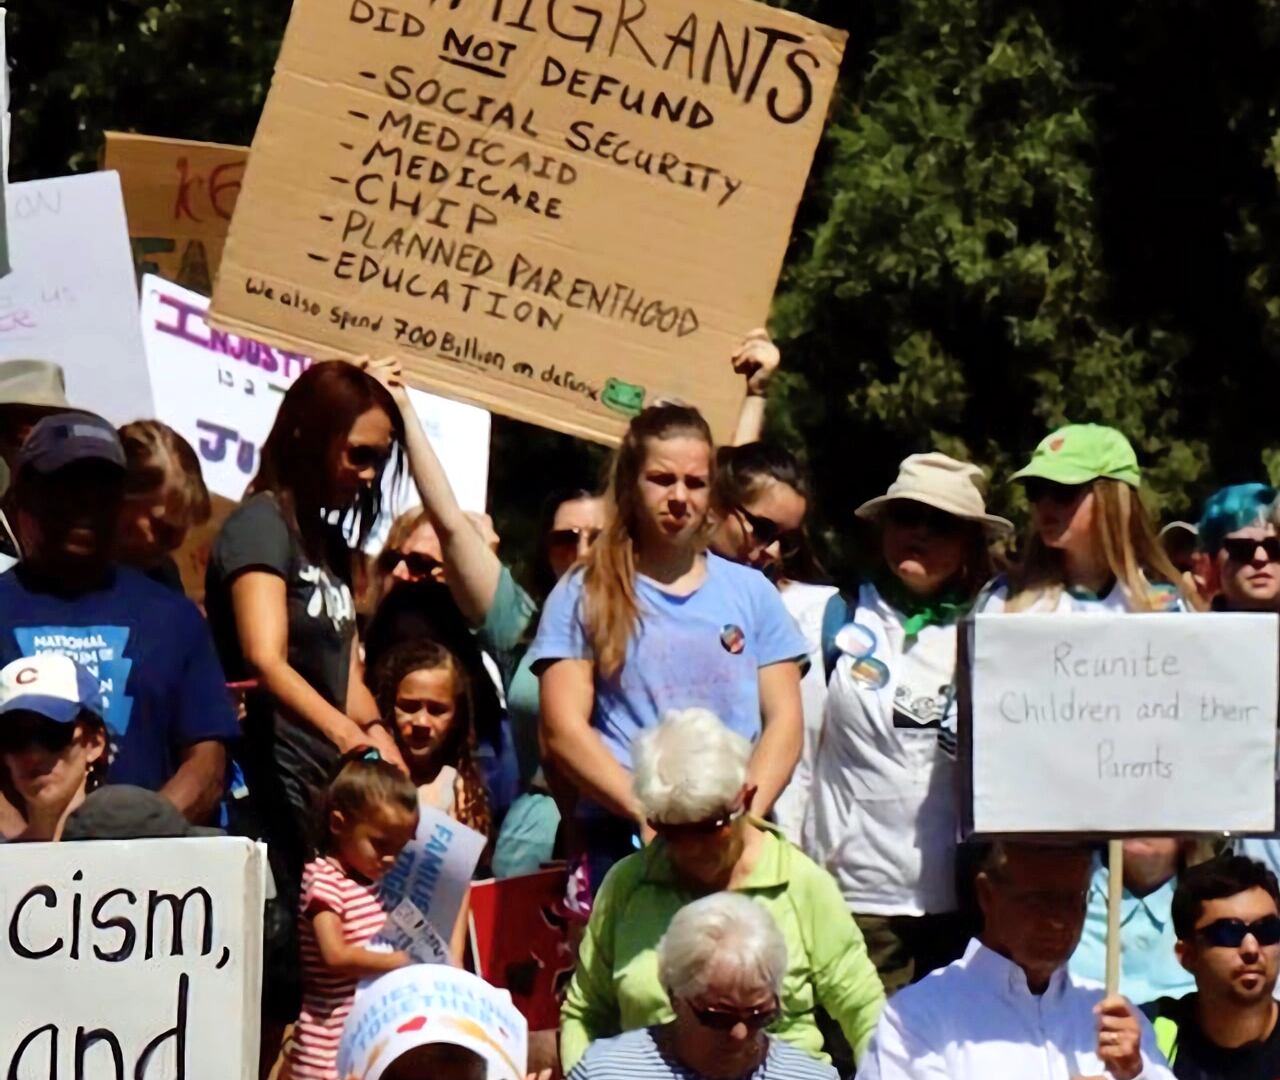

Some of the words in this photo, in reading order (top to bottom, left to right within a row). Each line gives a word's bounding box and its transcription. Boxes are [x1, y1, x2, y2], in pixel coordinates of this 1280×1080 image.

[350, 0, 425, 38] DID
[441, 28, 517, 70] NOT
[540, 56, 715, 129] DEFUND
[431, 0, 821, 124] IGRANTS
[566, 120, 744, 208] SECURITY
[245, 276, 276, 301] We
[280, 290, 321, 318] also
[394, 317, 438, 348] 700
[440, 332, 506, 372] Billion
[509, 251, 700, 337] PARENTHOOD
[15, 667, 39, 685] C
[33, 632, 107, 649] NATIONAL
[1052, 640, 1181, 679] Reunite
[1000, 686, 1121, 725] Children
[1136, 691, 1180, 722] and
[1200, 695, 1260, 724] their
[1096, 738, 1174, 781] Parents
[7, 869, 232, 970] cism,
